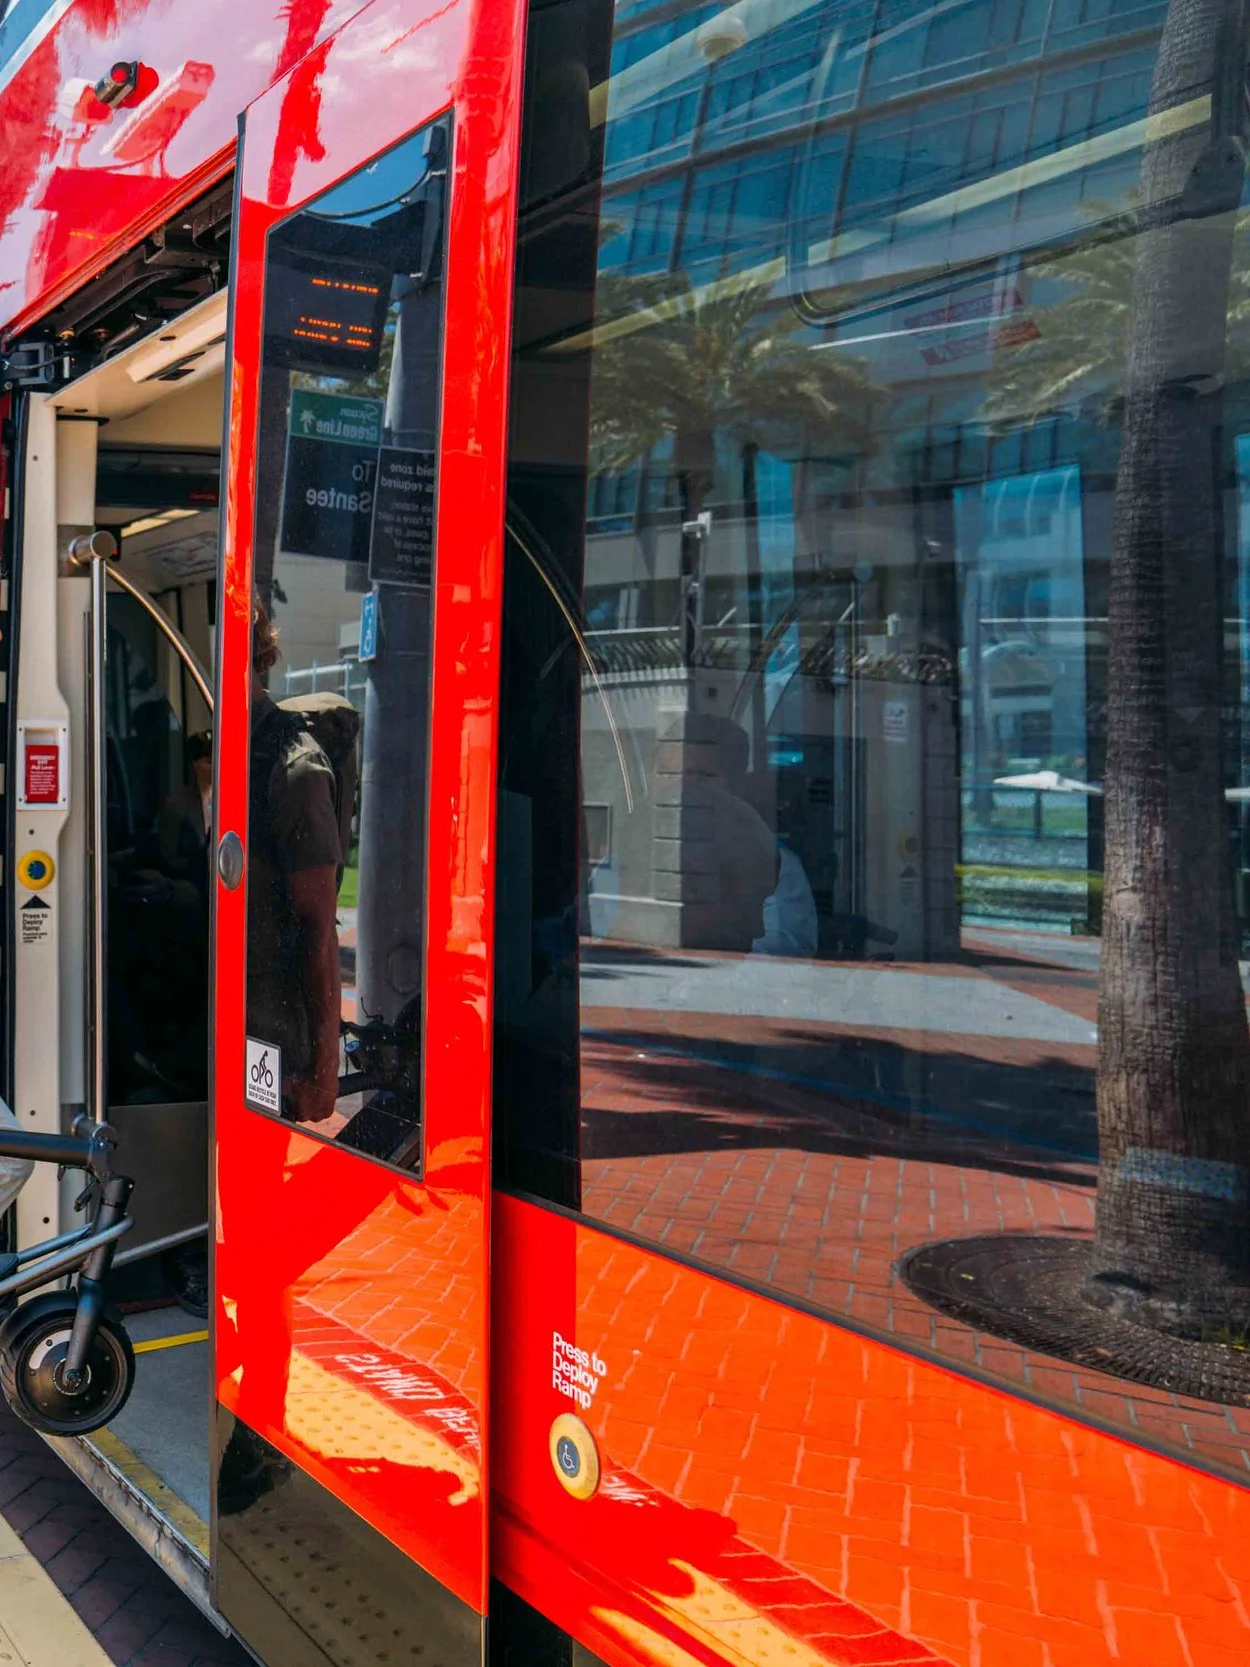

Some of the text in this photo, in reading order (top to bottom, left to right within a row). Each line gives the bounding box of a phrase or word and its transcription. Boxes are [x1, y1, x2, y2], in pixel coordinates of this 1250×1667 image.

[552, 1331, 607, 1377] Press to
[552, 1351, 599, 1395] Deploy
[552, 1372, 592, 1409] Ramp
